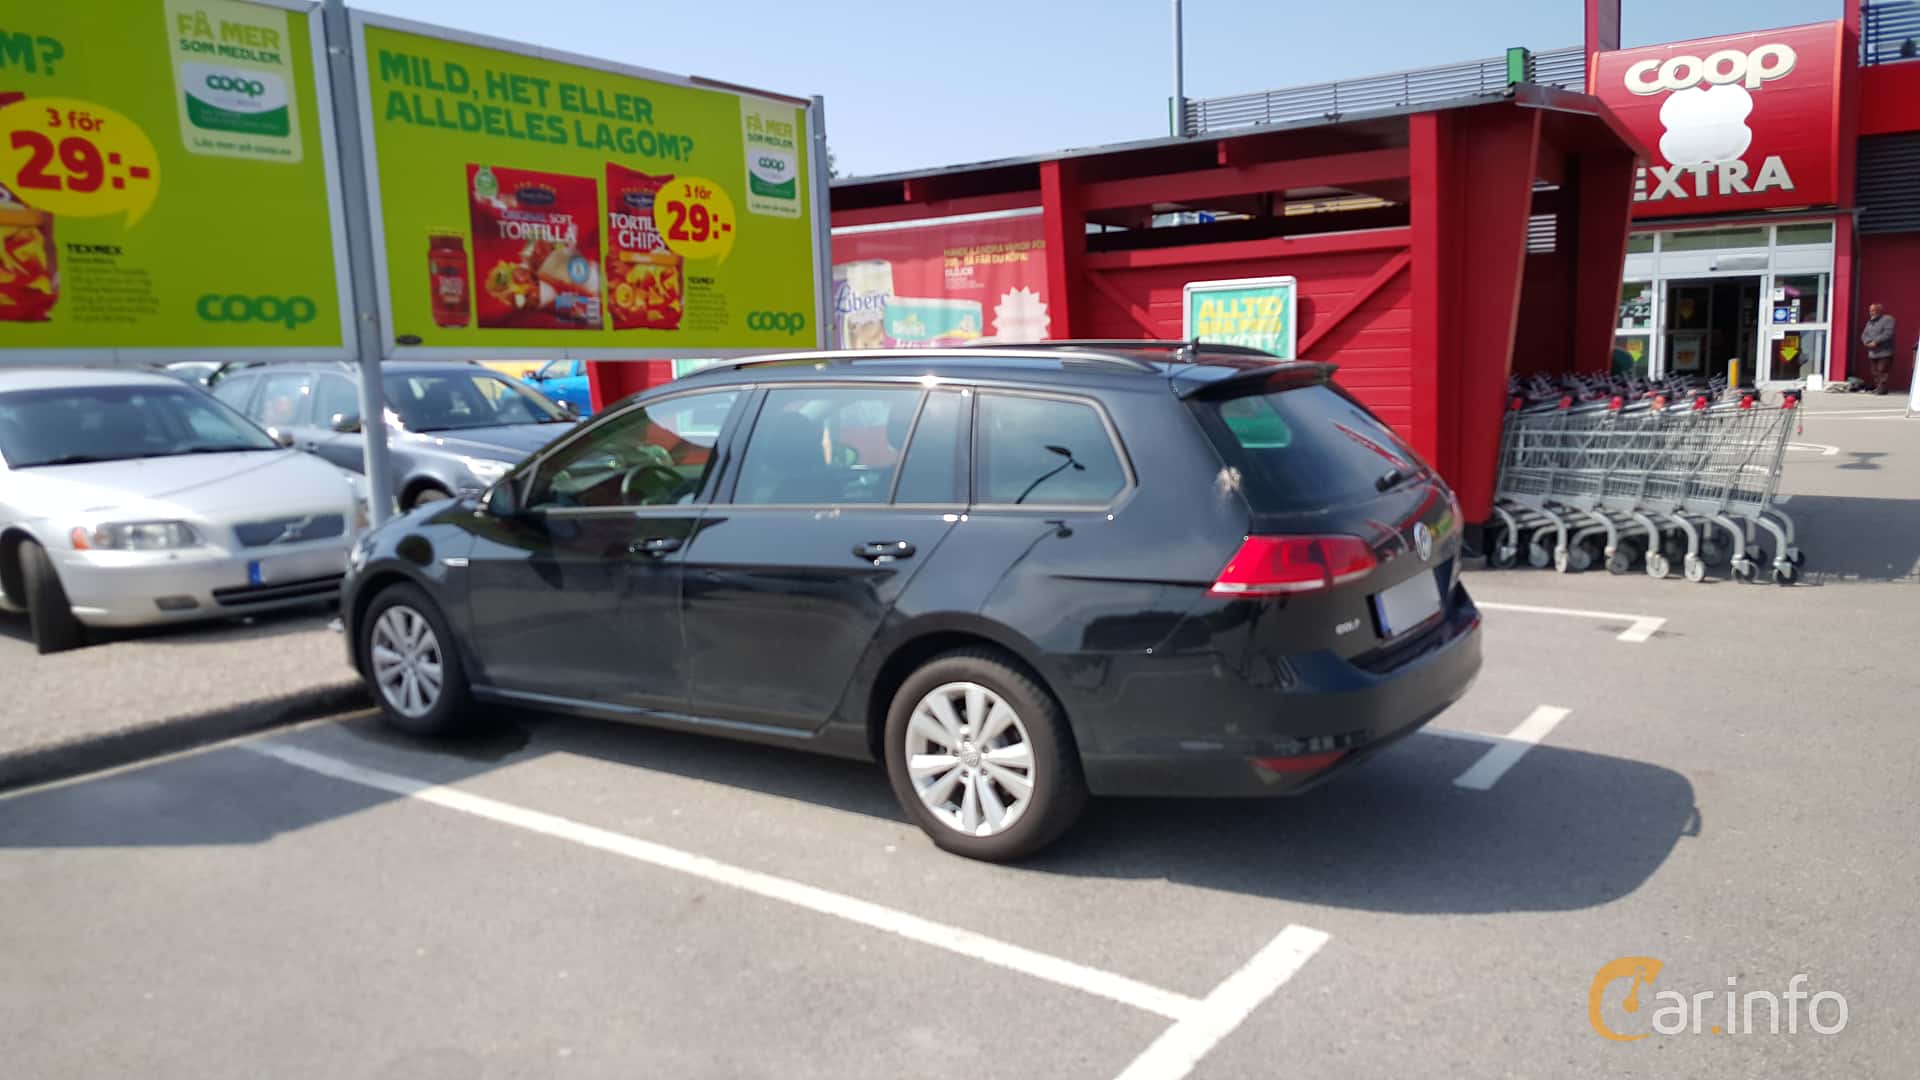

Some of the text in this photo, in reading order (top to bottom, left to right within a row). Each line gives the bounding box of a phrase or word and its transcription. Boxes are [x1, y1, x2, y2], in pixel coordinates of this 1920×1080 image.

[177, 10, 281, 49] FÅ MER
[180, 38, 215, 55] SOM
[1624, 44, 1797, 96] coop
[206, 74, 265, 98] coop
[378, 49, 655, 125] MILD, HET ELLER
[46, 108, 104, 132] 3 för
[384, 89, 694, 162] ALLDELES LAGOM?
[10, 130, 151, 193] 29:-
[758, 157, 785, 171] coop
[684, 184, 692, 198] 3
[496, 220, 578, 242] TORTILLA
[667, 200, 731, 242] 29:-
[196, 293, 316, 329] coop
[746, 310, 806, 336] coop
